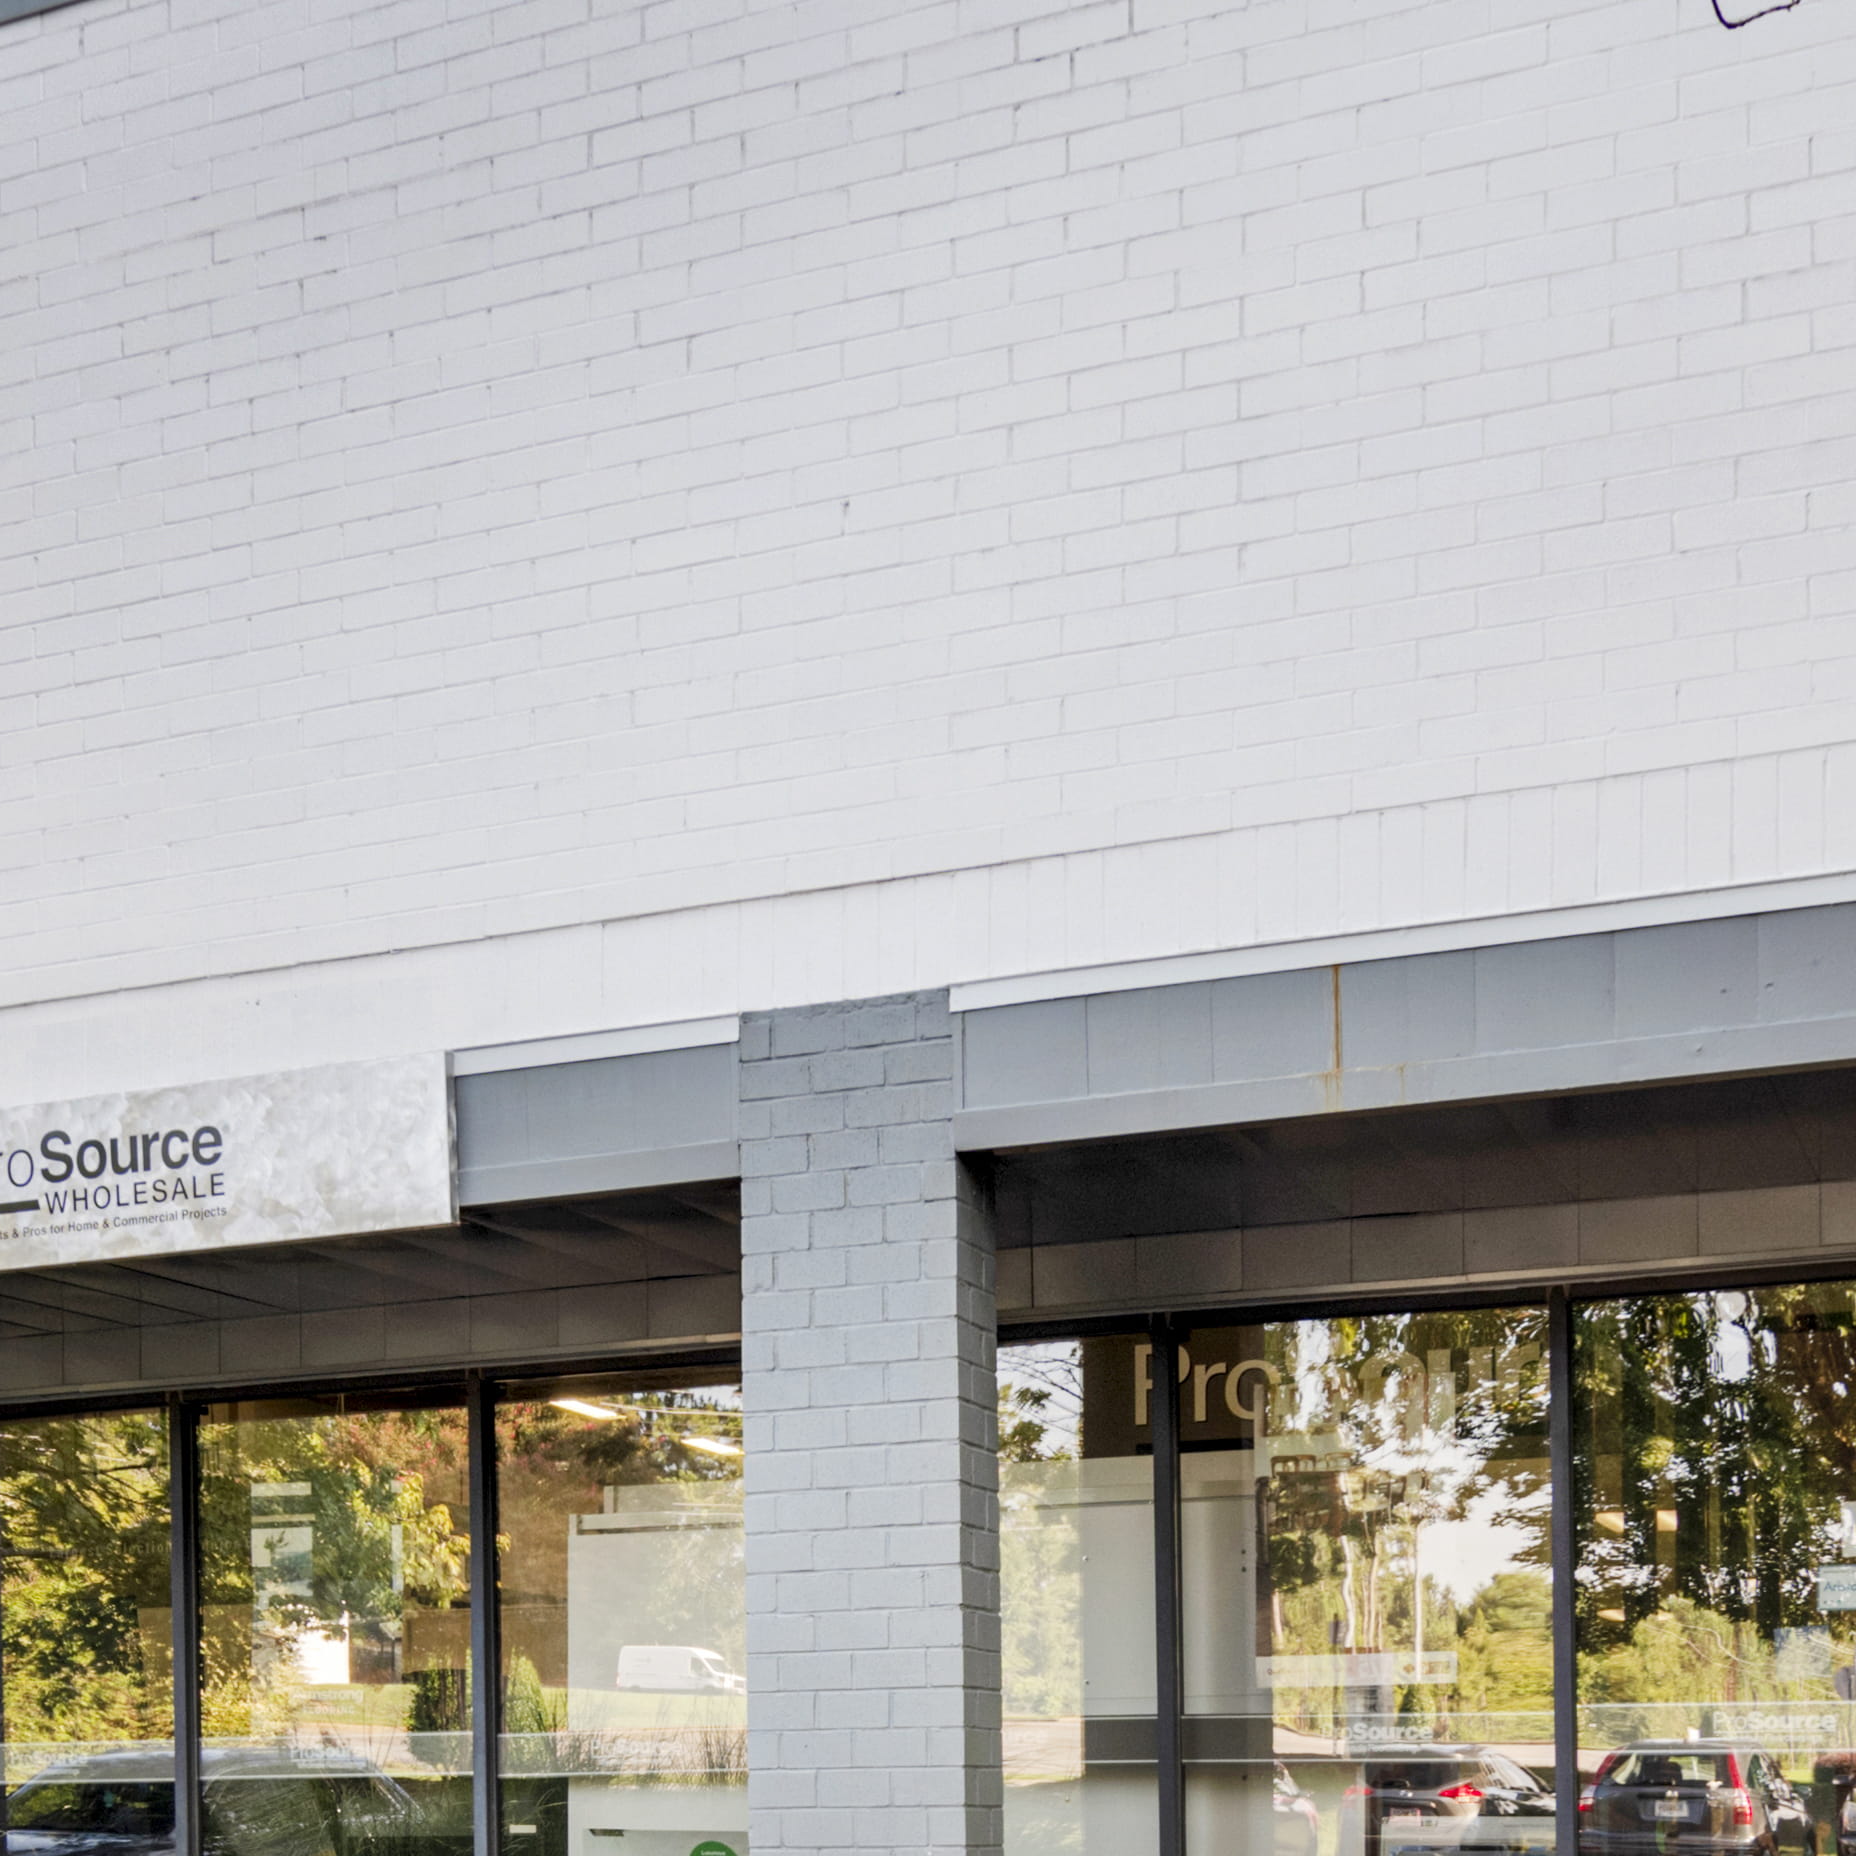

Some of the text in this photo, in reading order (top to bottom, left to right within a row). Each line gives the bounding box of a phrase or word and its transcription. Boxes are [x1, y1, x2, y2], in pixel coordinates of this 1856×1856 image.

[45, 1173, 225, 1215] WHOLESALE
[12, 1228, 19, 1239] &
[23, 1224, 48, 1238] Pros
[49, 1223, 65, 1234] for
[68, 1220, 100, 1232] Home
[103, 1219, 110, 1229] &
[113, 1211, 178, 1227] Commercial
[181, 1206, 228, 1221] Projects
